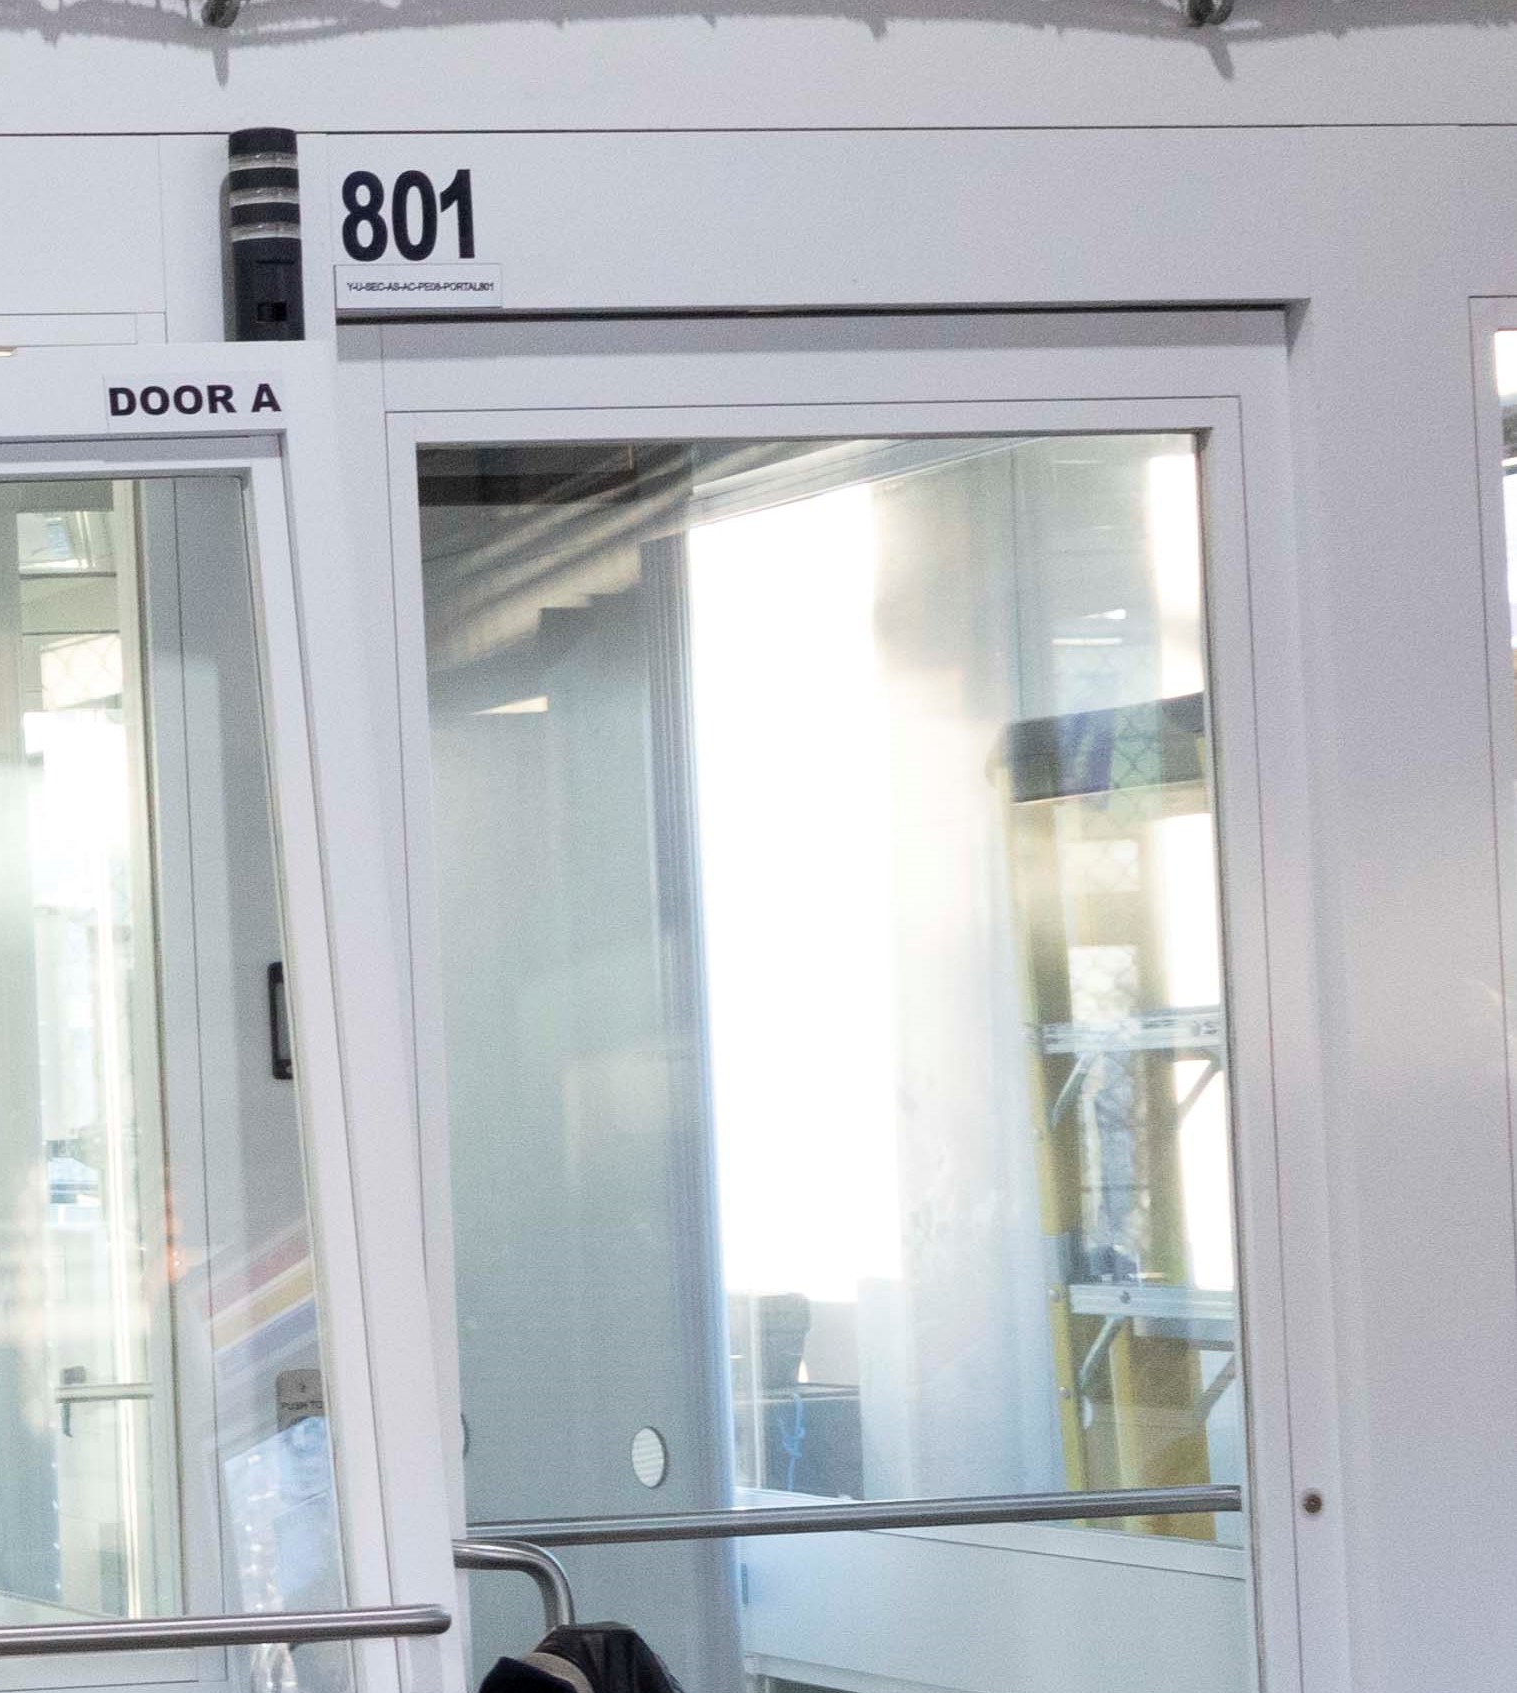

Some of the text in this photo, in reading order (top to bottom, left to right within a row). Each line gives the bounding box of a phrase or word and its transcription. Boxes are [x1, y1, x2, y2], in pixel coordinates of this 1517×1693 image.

[342, 169, 475, 261] 801
[109, 384, 282, 416] DOOR A
